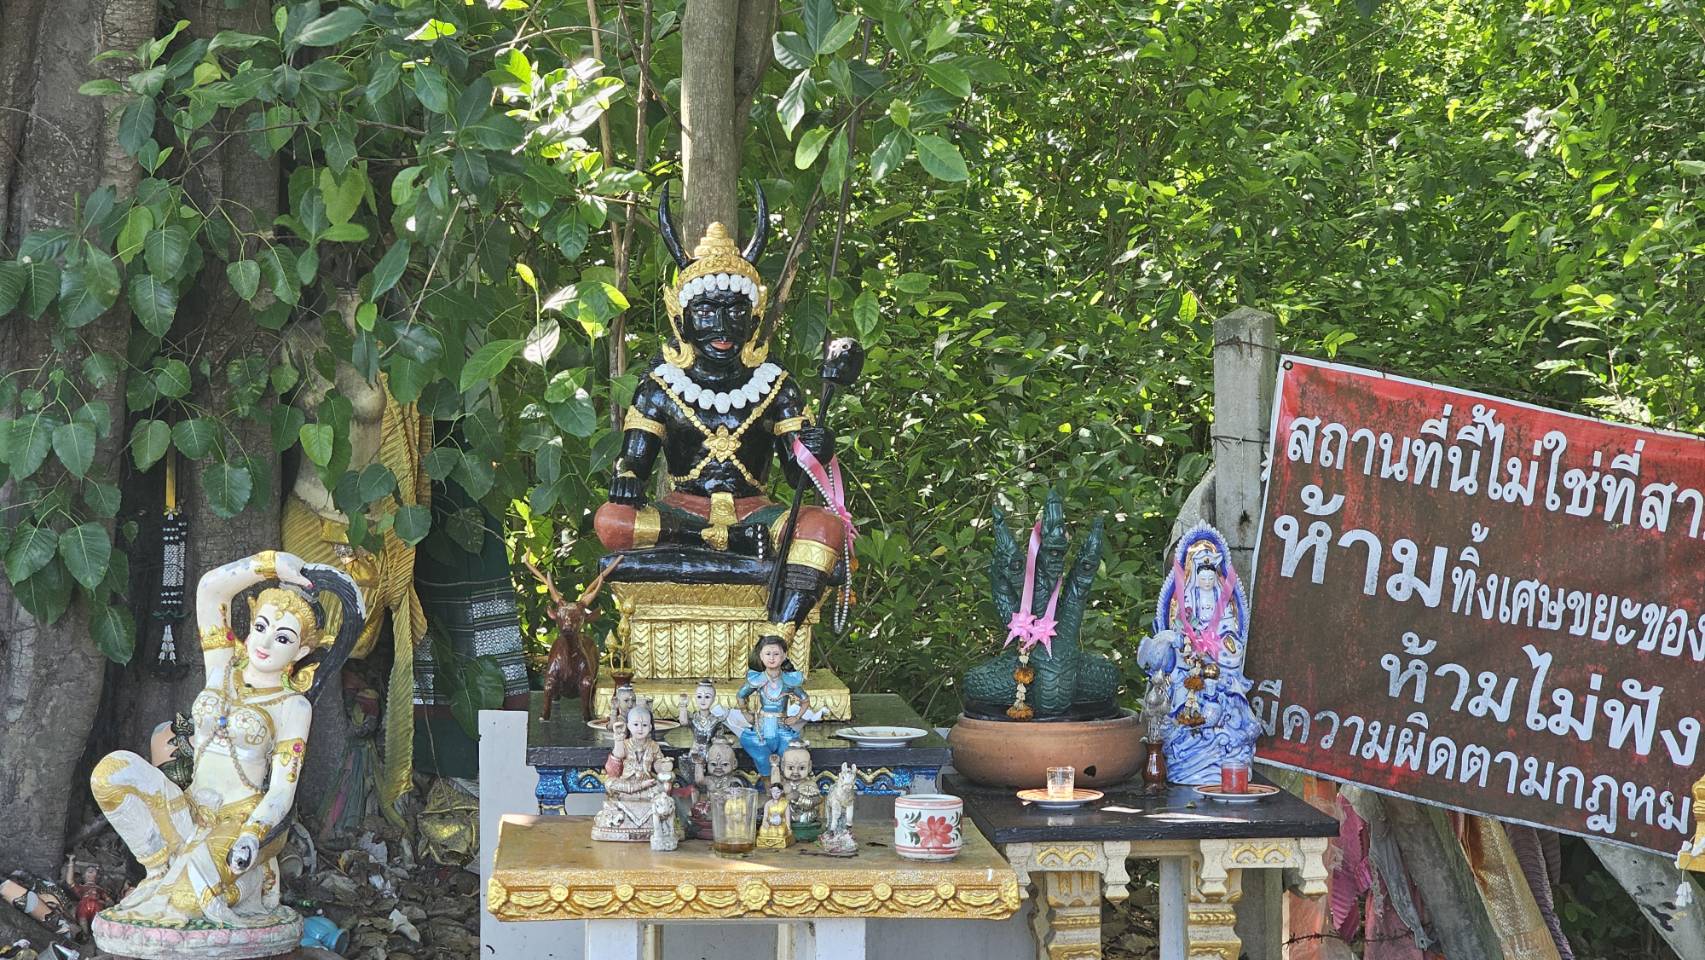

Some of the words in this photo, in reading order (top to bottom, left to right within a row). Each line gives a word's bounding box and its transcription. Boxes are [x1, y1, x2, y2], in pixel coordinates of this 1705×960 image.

[1288, 404, 1705, 540] สถานที่นี้ไม่ใช่ที่สา
[1380, 631, 1700, 766] ห้ามไม่ฟัง
